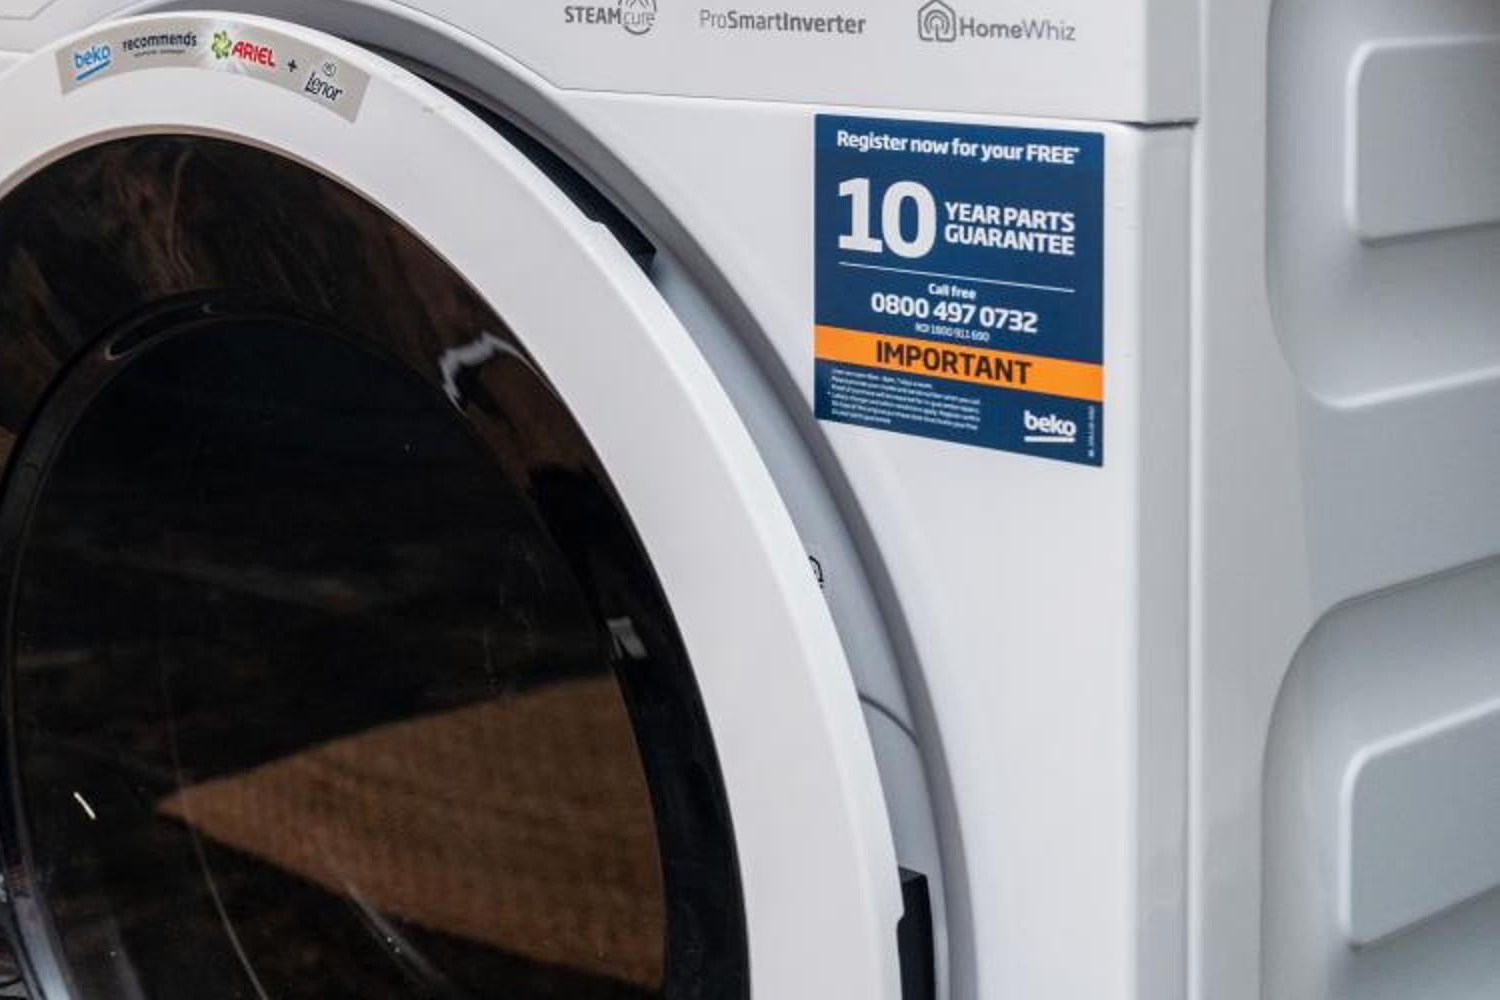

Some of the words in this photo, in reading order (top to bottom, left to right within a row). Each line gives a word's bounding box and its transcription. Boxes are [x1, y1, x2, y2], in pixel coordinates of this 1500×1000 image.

[700, 8, 867, 35] ProSmartInverter
[959, 16, 1076, 42] HomeWhiz
[73, 44, 111, 70] beko
[122, 30, 197, 54] recommends
[231, 40, 277, 69] ARIEL
[304, 72, 343, 102] Lenor
[836, 130, 908, 153] Register
[910, 140, 949, 155] now
[952, 138, 979, 158] for
[981, 143, 1024, 163] your
[838, 177, 937, 259] 10
[945, 201, 1000, 227] YEAR
[1004, 208, 1075, 233] PARTS
[945, 223, 1075, 256] GUARANTEE
[928, 282, 950, 297] Call
[951, 283, 977, 300] free
[871, 292, 929, 319] 0800
[933, 299, 976, 325] 497
[979, 306, 1039, 334] 0732
[876, 340, 1032, 385] IMPORTANT
[1023, 409, 1077, 437] beko
